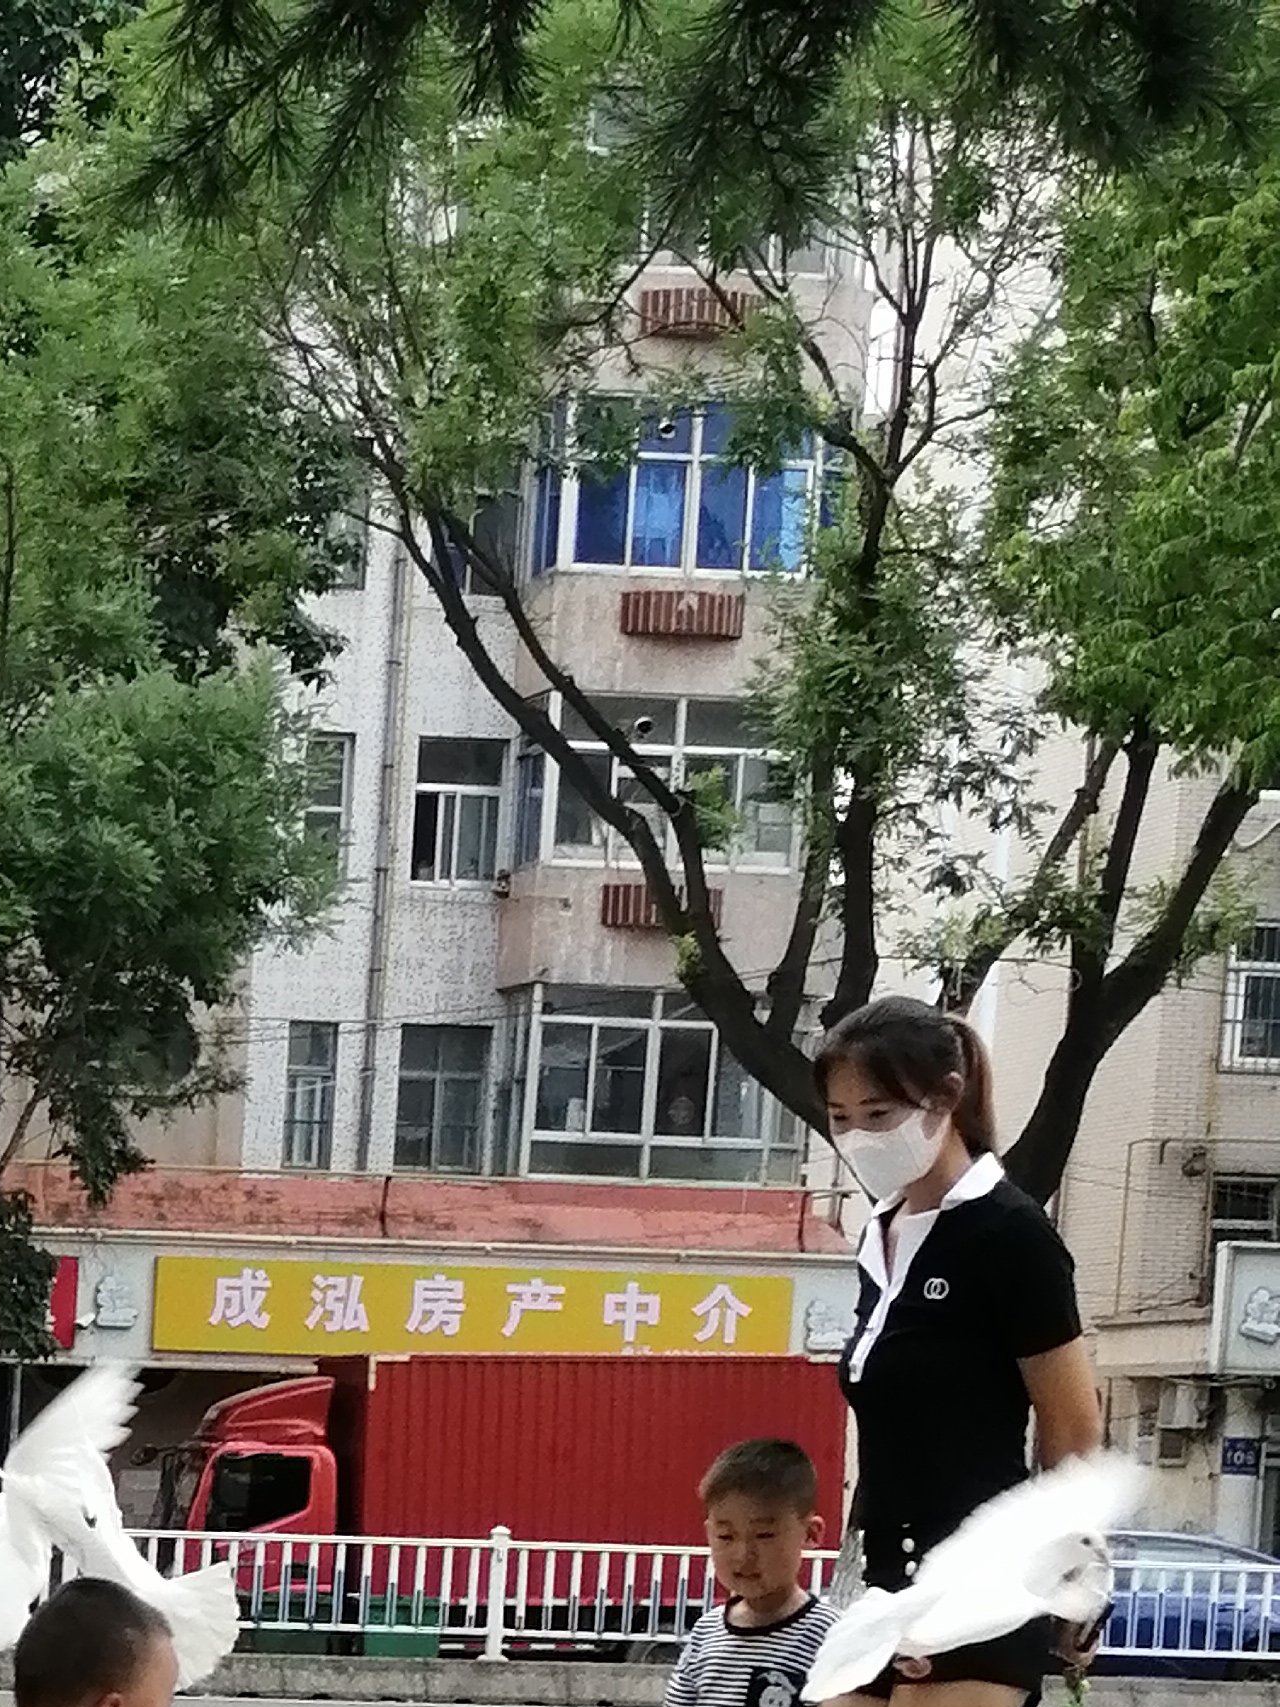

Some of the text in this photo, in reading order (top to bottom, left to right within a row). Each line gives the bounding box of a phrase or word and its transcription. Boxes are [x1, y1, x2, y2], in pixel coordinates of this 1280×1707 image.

[209, 1268, 753, 1344] 成泓房产中介
